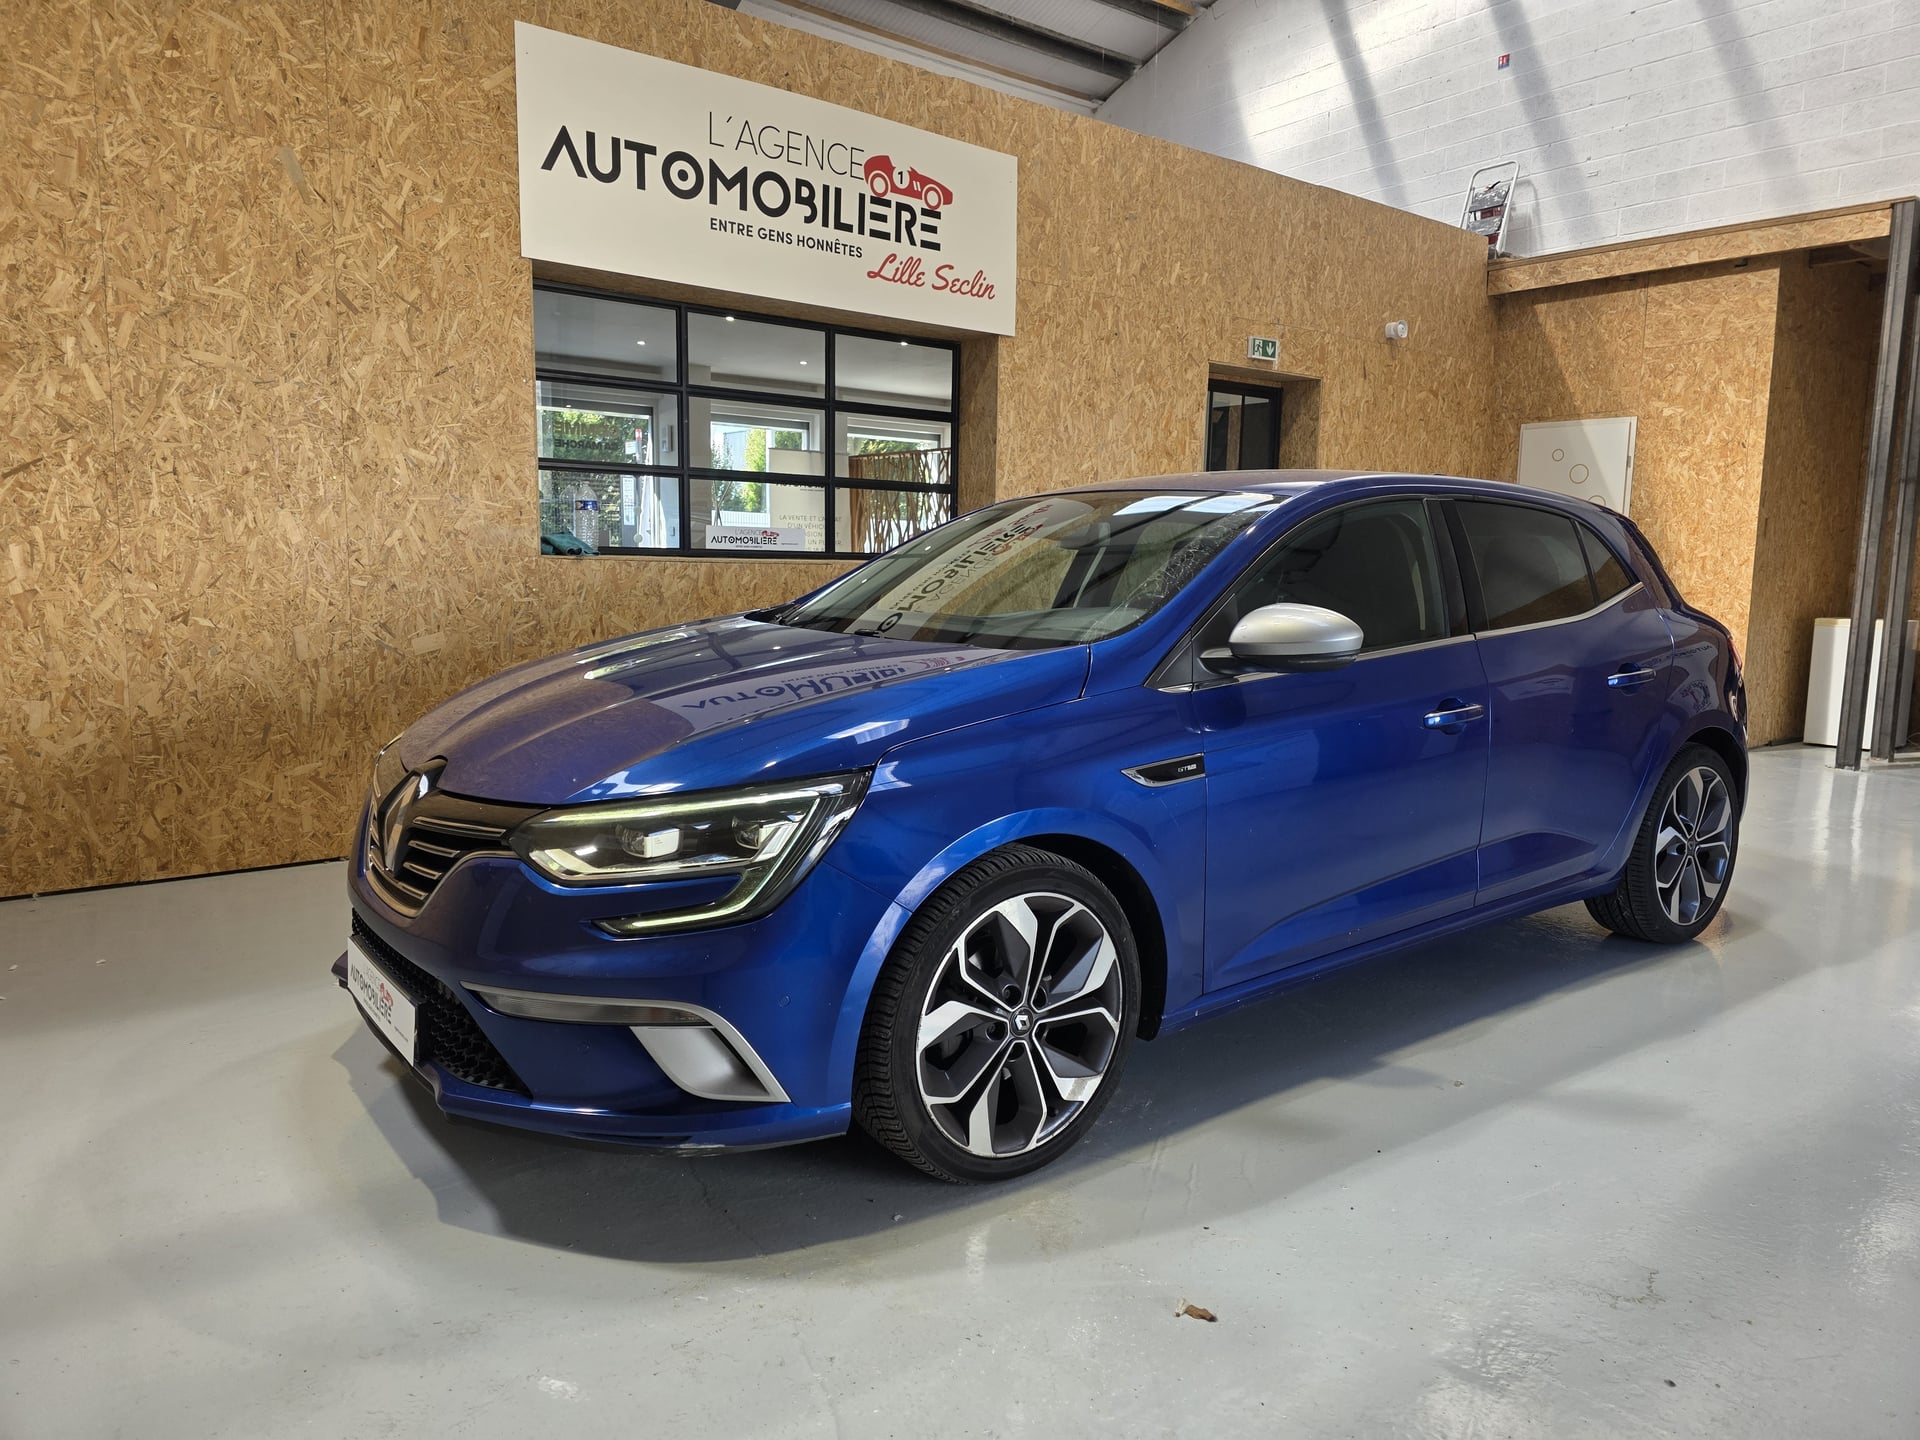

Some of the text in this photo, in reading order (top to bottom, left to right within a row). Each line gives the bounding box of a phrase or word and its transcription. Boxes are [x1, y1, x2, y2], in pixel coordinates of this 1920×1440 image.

[709, 111, 865, 180] L'AGENCE
[710, 217, 863, 258] ENTRE GENS HONNÊTES
[867, 253, 995, 299] Lille Seclin
